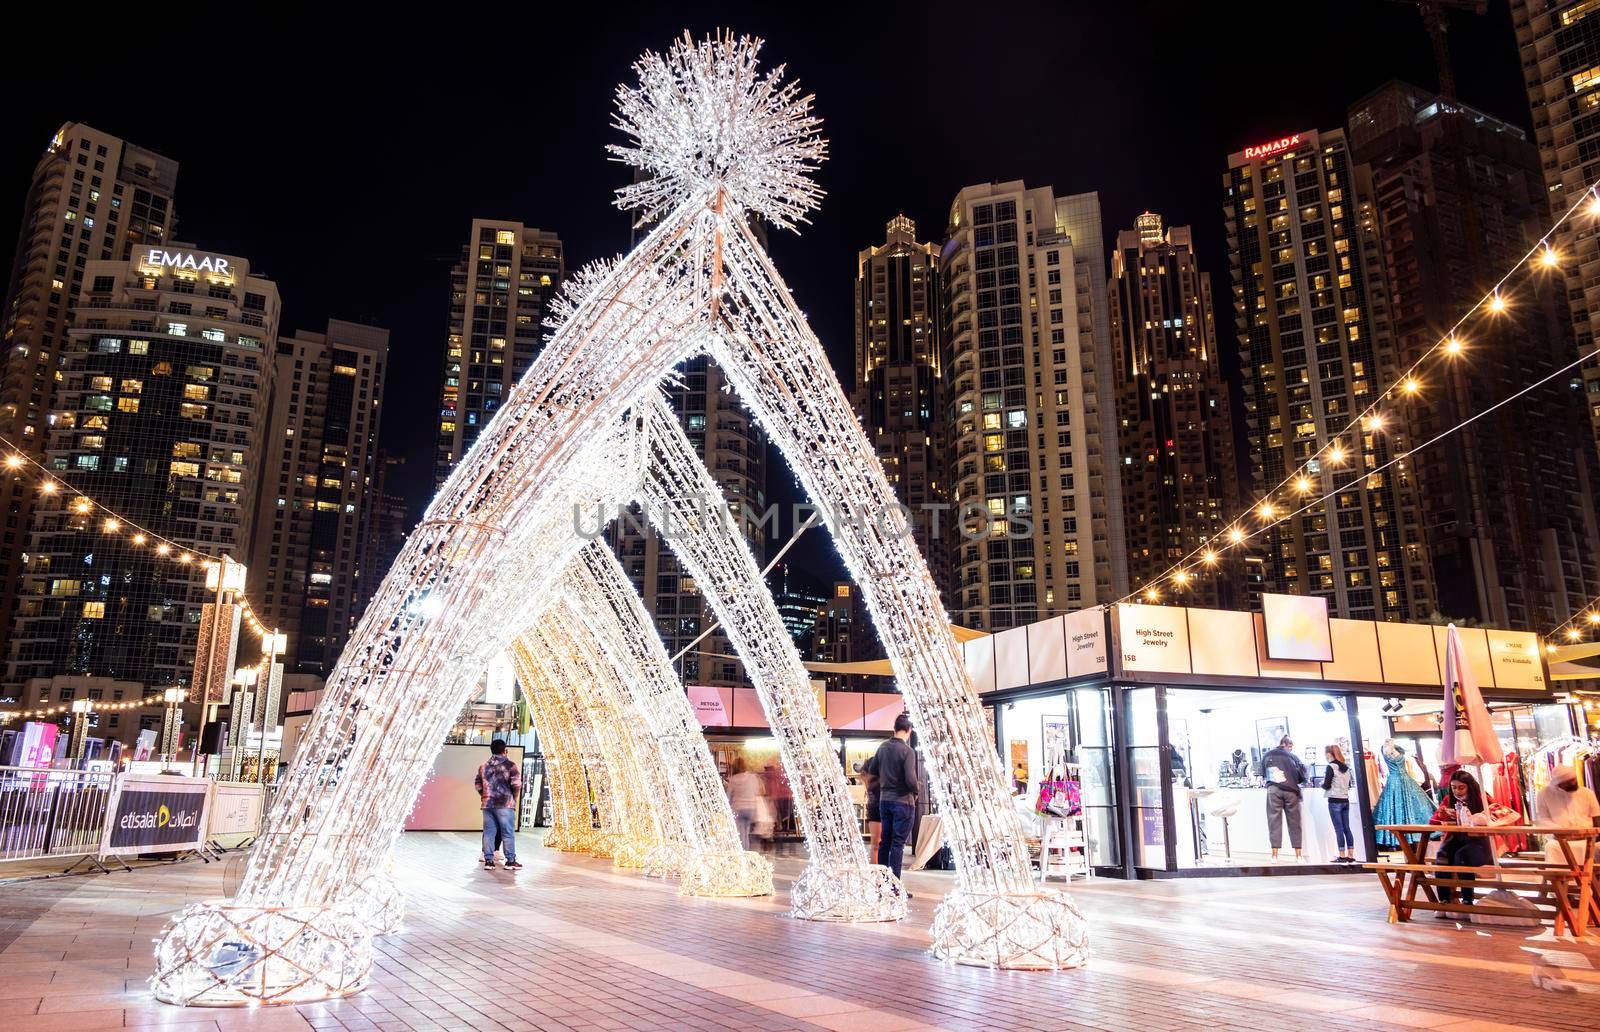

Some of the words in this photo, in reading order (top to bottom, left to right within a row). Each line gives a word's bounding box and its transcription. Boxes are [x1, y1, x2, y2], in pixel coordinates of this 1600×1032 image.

[1245, 135, 1299, 158] RAMADA
[148, 249, 229, 276] EMAAR
[1072, 633, 1083, 643] High
[1083, 631, 1099, 640] Street
[1136, 629, 1151, 638] High
[1152, 629, 1174, 638] Street
[1076, 641, 1095, 651] Jewelry
[1142, 639, 1168, 648] Jewelry
[1124, 654, 1137, 662] 15B
[121, 810, 158, 829] etisalat
[169, 809, 198, 830] اتصالات
